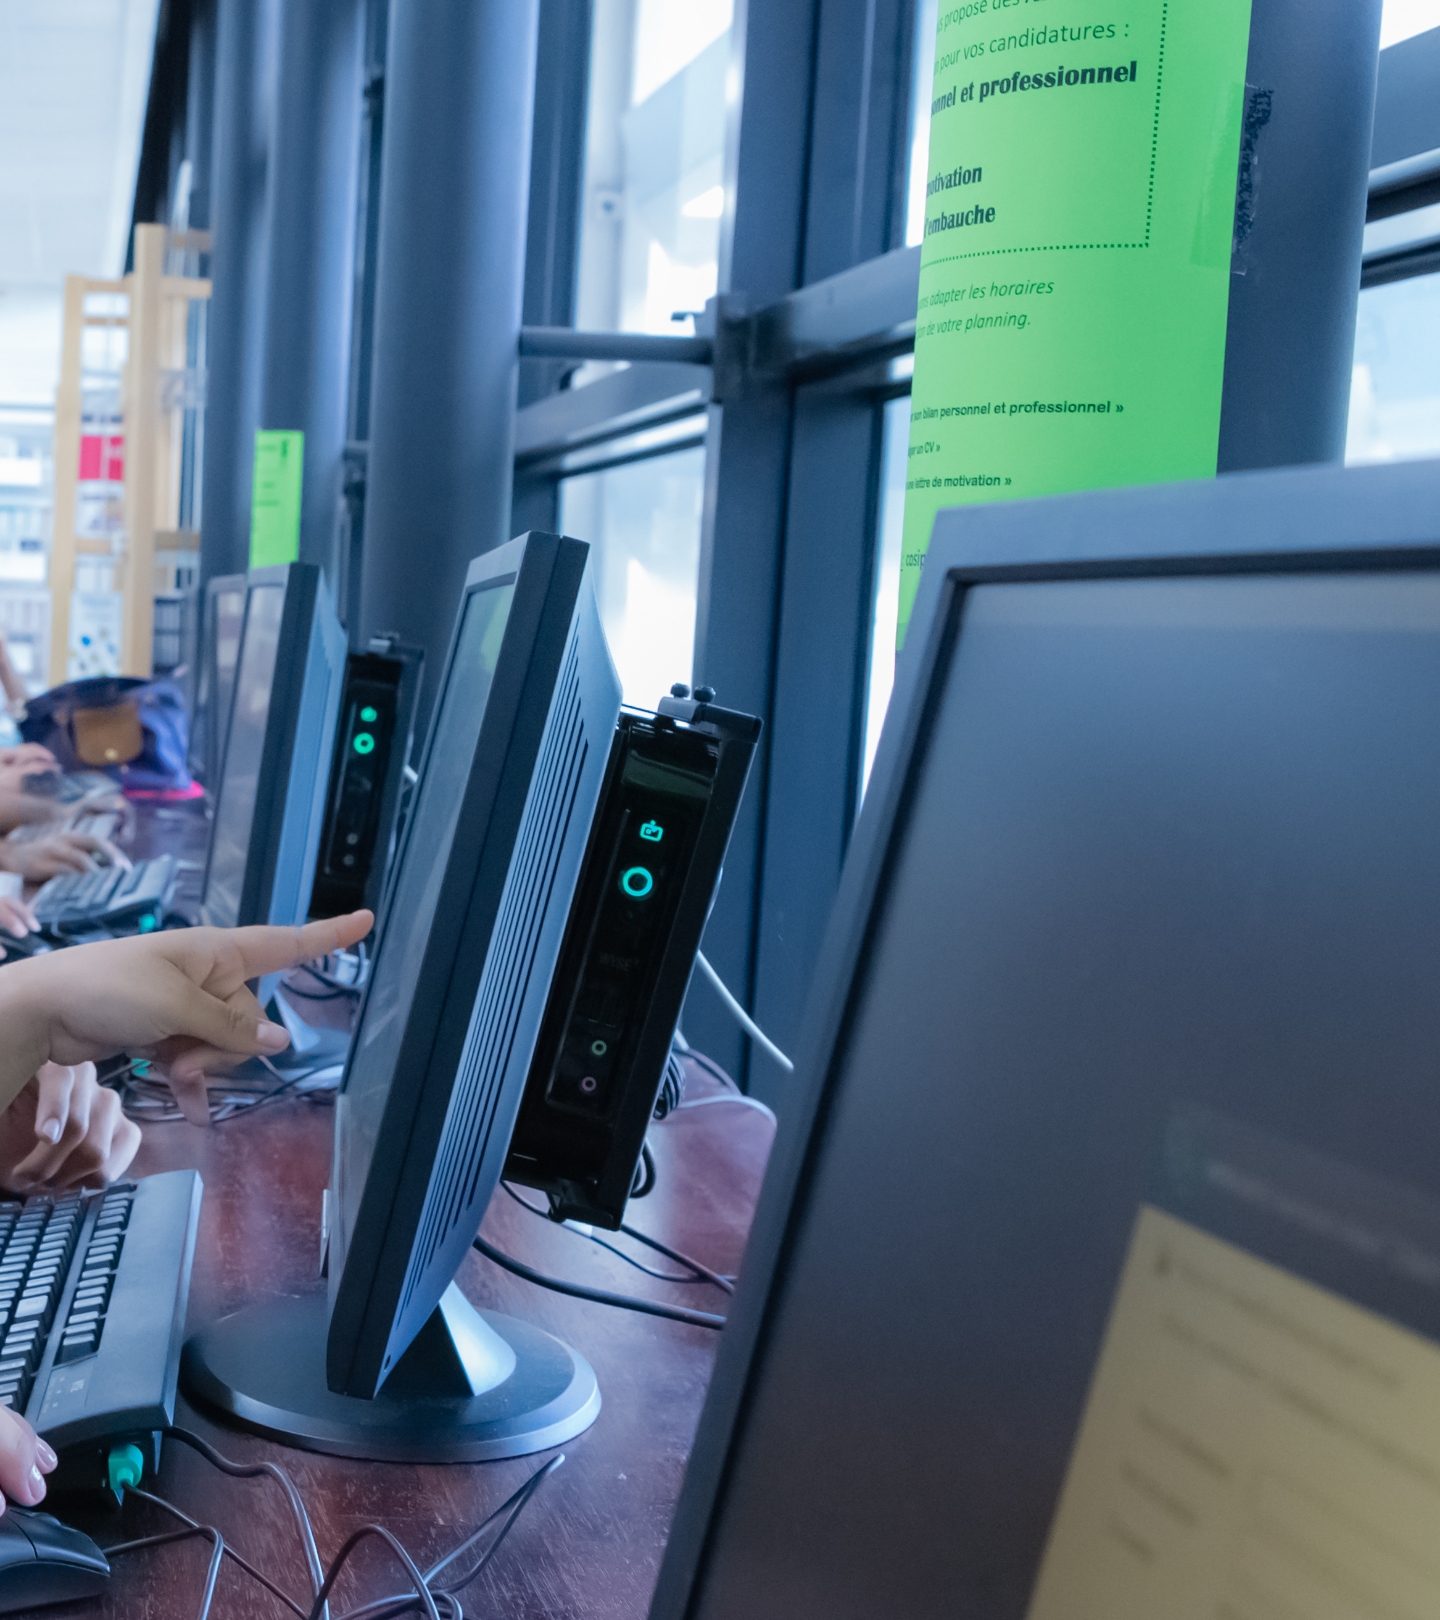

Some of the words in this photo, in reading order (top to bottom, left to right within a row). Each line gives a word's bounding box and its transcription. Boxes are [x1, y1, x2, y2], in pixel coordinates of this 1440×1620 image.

[943, 0, 987, 32] propose
[940, 49, 961, 74] pour
[964, 42, 985, 60] vos
[989, 23, 1116, 53] candidatures
[961, 81, 974, 103] et
[979, 60, 1137, 103] professionnel
[929, 288, 967, 307] adapter
[969, 284, 987, 299] les
[990, 280, 1055, 298] horaires
[937, 319, 962, 334] votre
[965, 312, 1031, 333] planning.
[923, 407, 939, 419] bilan
[940, 402, 991, 420] personnel
[994, 402, 1006, 414] et
[1009, 400, 1111, 417] professionnel
[925, 441, 935, 453] CV
[932, 476, 942, 488] de
[944, 475, 1001, 488] motivation
